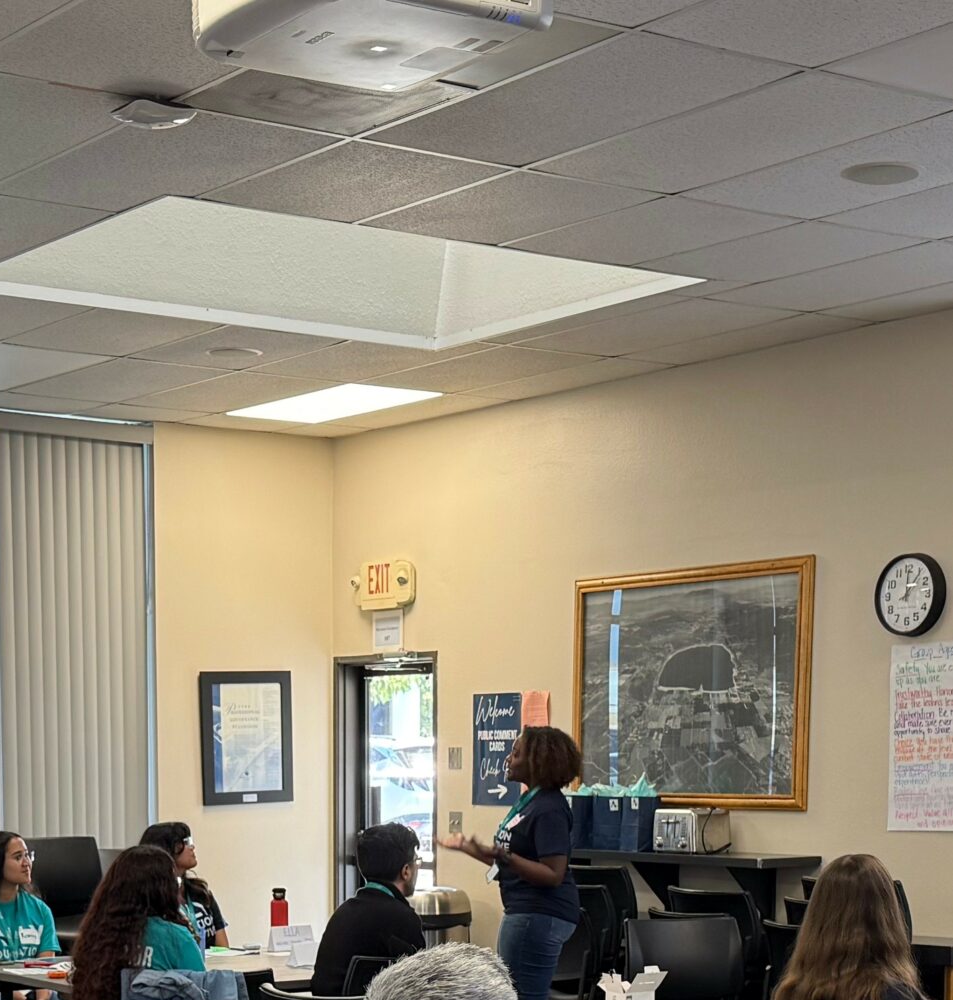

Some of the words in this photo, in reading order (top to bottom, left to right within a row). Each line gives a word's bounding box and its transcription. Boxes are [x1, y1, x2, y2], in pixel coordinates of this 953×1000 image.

[896, 569, 902, 578] 11
[905, 564, 914, 574] 12
[368, 563, 390, 594] EXIT
[922, 577, 928, 586] 2
[888, 580, 896, 590] 10
[885, 592, 891, 602] 9
[925, 589, 931, 599] 3
[888, 605, 894, 614] 8
[920, 602, 927, 611] 4
[894, 614, 900, 623] 7
[903, 617, 910, 626] 6
[913, 612, 919, 622] 5
[475, 695, 515, 725] Welcome
[477, 730, 494, 740] PUBLIC
[494, 730, 518, 740] COMMENT
[489, 741, 505, 752] CARDS
